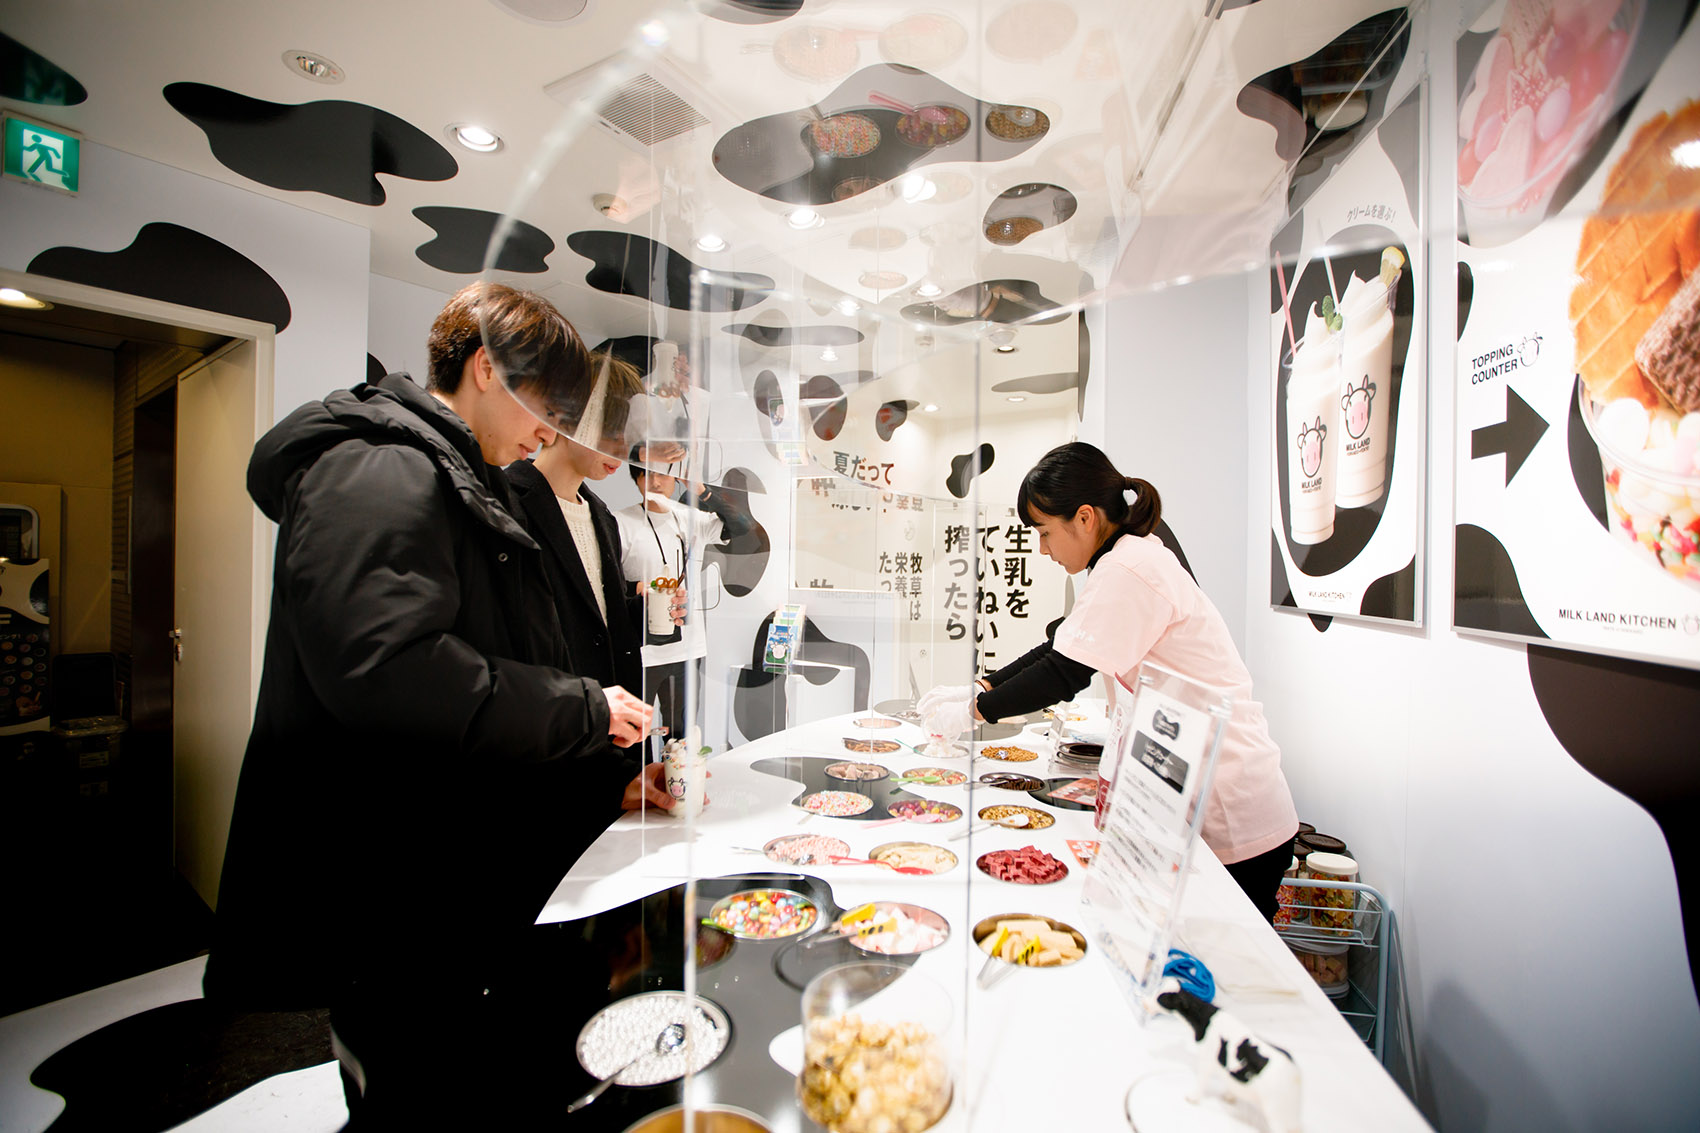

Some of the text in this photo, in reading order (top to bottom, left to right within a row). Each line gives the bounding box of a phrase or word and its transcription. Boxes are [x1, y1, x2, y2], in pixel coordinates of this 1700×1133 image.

[1471, 344, 1513, 369] TOPPING
[1471, 358, 1518, 385] COUNTER
[833, 451, 894, 485] 夏だって
[909, 552, 923, 621] 牧草は
[944, 525, 970, 641] 搾ったら
[1004, 524, 1033, 619] 生乳を
[973, 525, 1000, 675] ていねいに
[1559, 608, 1582, 620] MILK
[1586, 611, 1616, 624] LAND
[1620, 613, 1677, 630] KITCHEN
